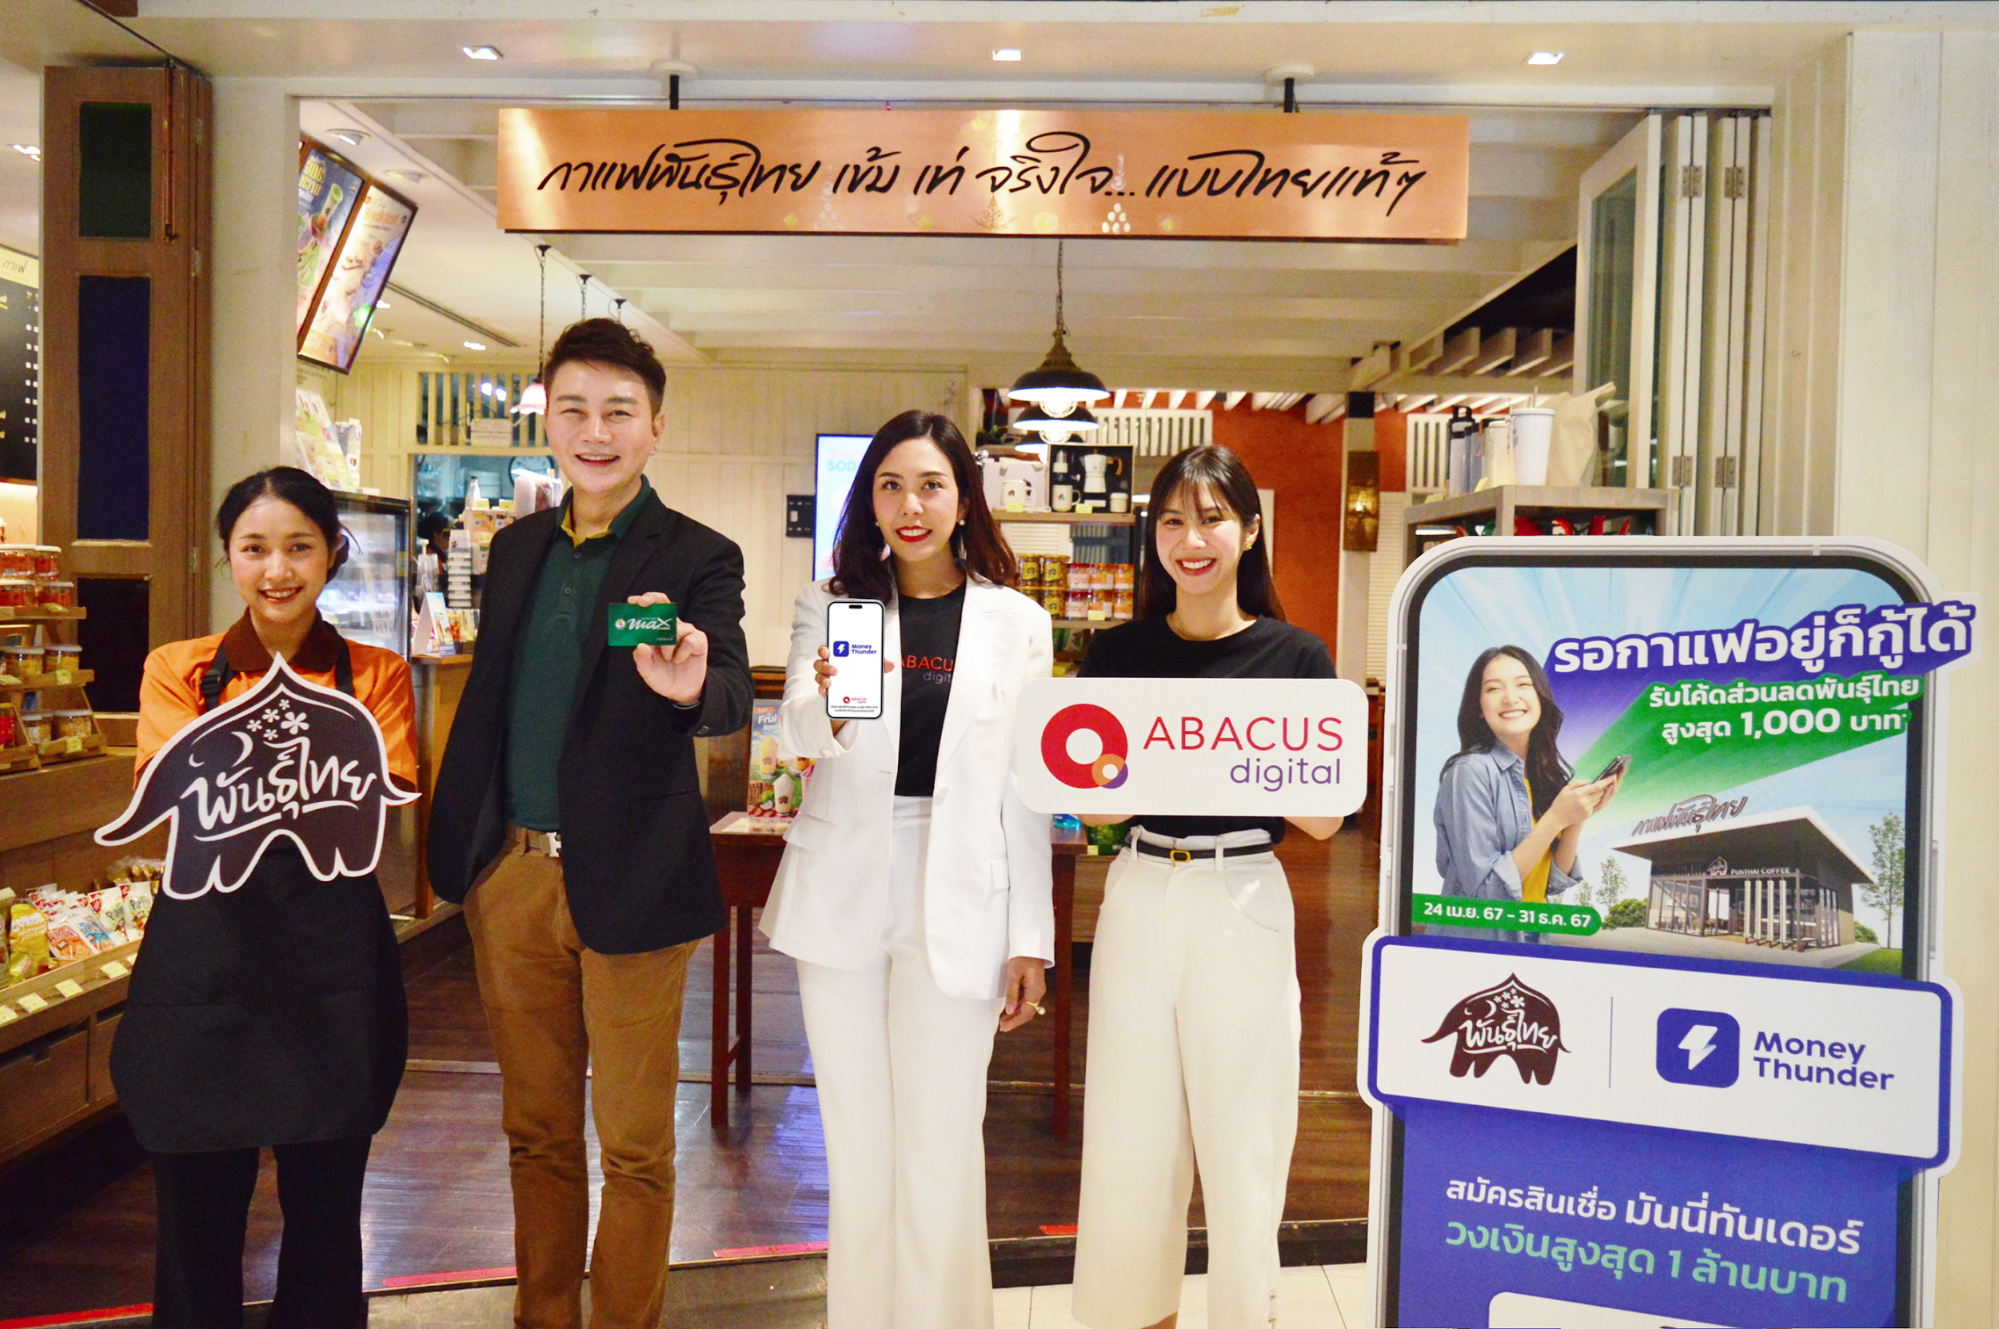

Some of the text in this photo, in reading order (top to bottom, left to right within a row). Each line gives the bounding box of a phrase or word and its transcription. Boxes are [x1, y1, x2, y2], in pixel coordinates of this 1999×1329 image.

[537, 138, 821, 205] กาแฟพันธุ์ไทย
[832, 147, 902, 195] เข้ม
[913, 147, 970, 196] เท่
[1554, 604, 1972, 674] รอกาแฟอยู่ก็กู้ได้
[1649, 674, 1919, 708] รับโค้ดส่วนลดพันธุ์ไทย
[1143, 716, 1343, 751] ABACUS
[1662, 719, 1731, 745] สูงสุด
[1740, 708, 1841, 740] 1,000
[180, 736, 377, 830] พันธุ์ไทย
[1230, 757, 1341, 792] digital
[1631, 794, 1749, 833] กาแฟพันธุ์ไทย
[1423, 902, 1442, 916] 24
[1446, 905, 1479, 919] เม.ย.
[1483, 907, 1503, 920] 67
[1519, 910, 1535, 923] 31
[1538, 911, 1567, 926] ธ.ค.
[1570, 914, 1591, 928] 67
[1459, 1009, 1557, 1049] พันธุ์ไทย
[1753, 1031, 1866, 1065] Money
[1753, 1057, 1895, 1091] Thunder
[1446, 1177, 1864, 1255] สมัครสินเชื่อ มันนี่ทันเดอร์
[1446, 1221, 1848, 1303] วงเงินสูงสุด 1 ล้านบาท
